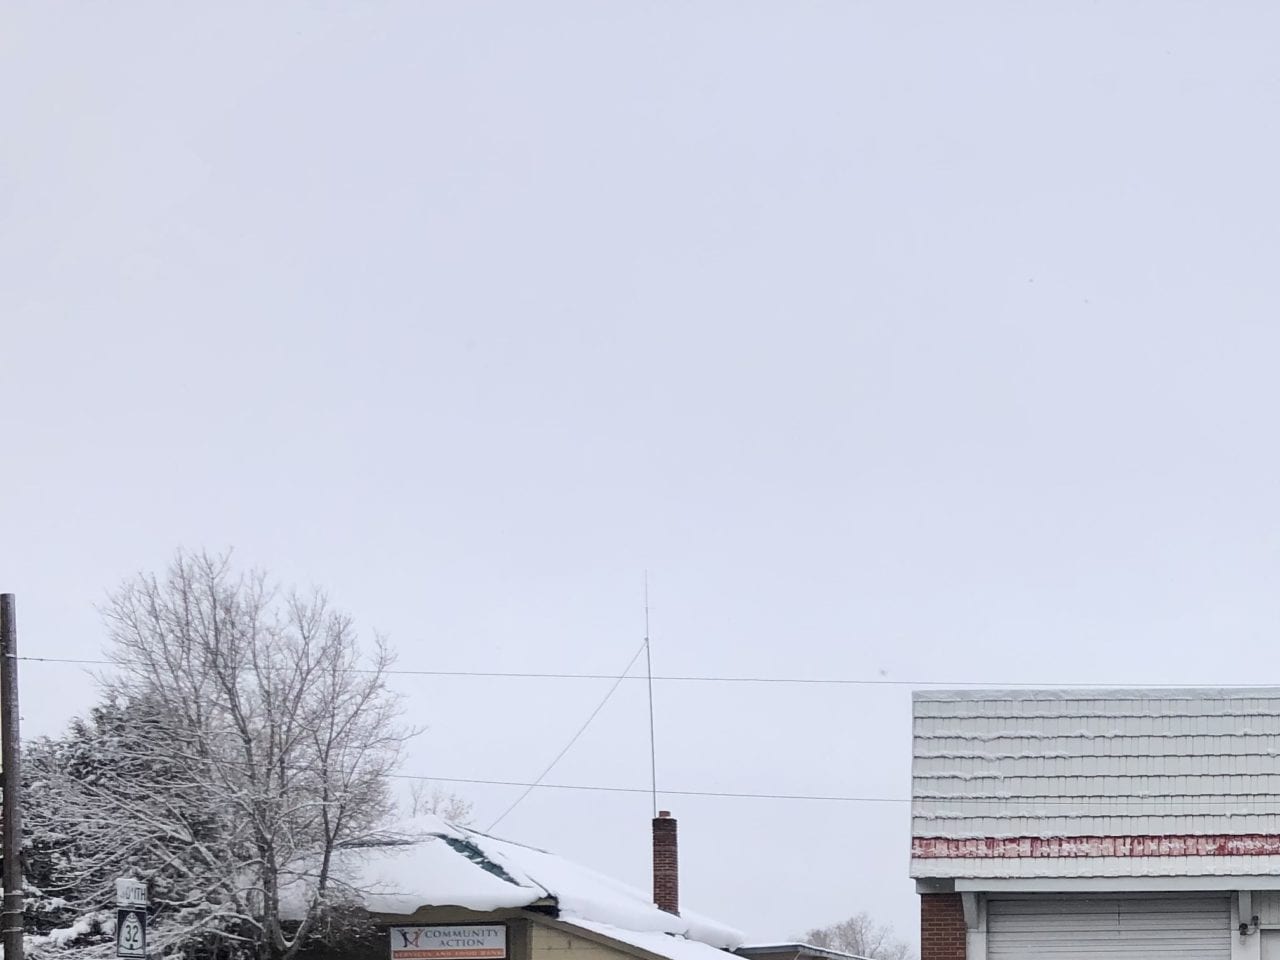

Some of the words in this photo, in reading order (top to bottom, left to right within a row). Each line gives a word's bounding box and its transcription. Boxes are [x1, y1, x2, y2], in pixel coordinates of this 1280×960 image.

[119, 887, 145, 901] OUTH
[125, 924, 139, 943] 32
[424, 928, 499, 939] COMMUNITY
[440, 938, 485, 947] ACTION
